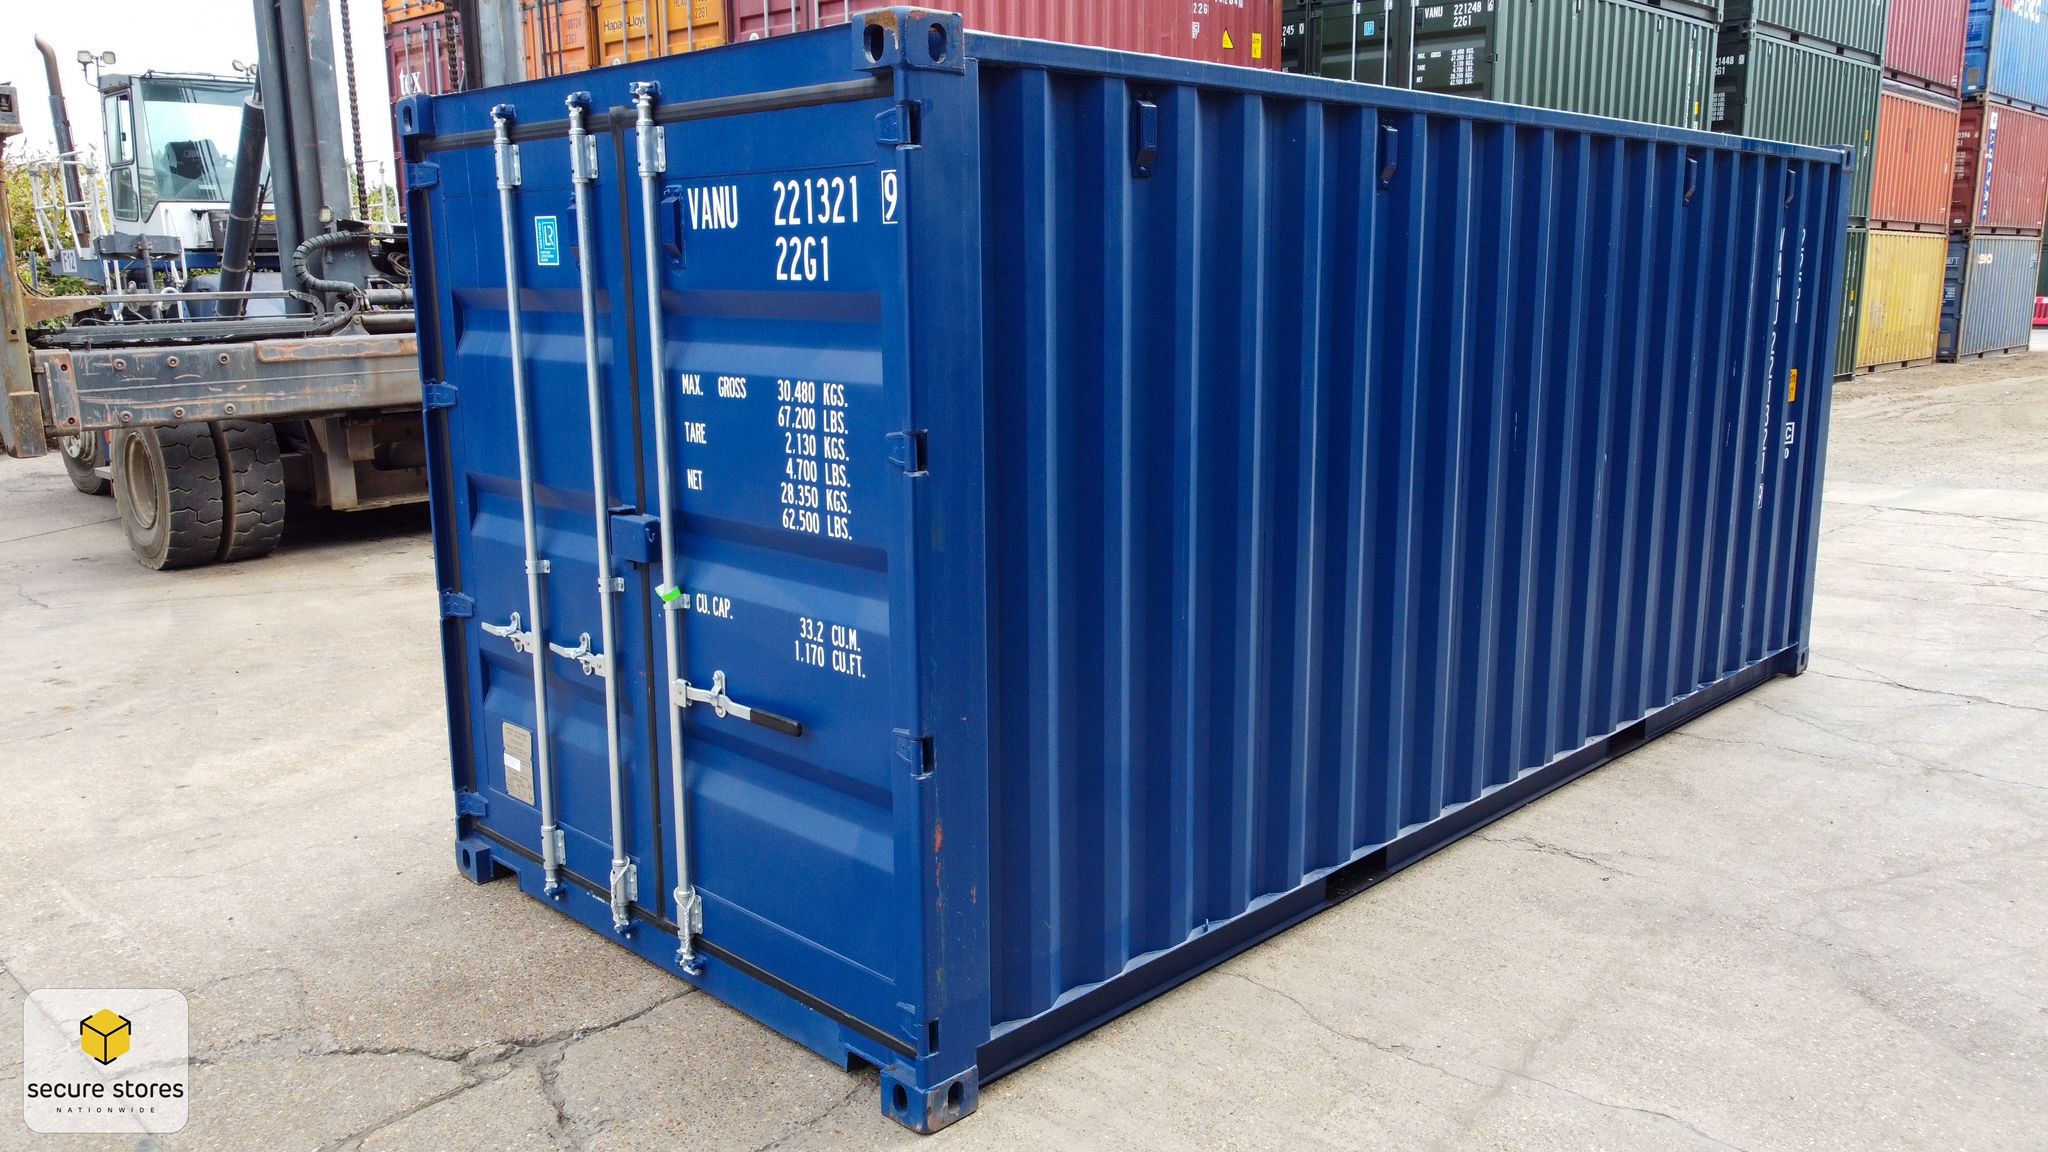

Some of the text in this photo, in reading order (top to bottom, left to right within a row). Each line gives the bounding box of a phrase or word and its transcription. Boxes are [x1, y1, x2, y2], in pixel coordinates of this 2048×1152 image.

[1425, 6, 1443, 19] VANU
[1453, 2, 1482, 15] 221248
[1453, 15, 1472, 27] 22G1
[688, 171, 899, 230] VANU 221321 9
[775, 235, 830, 282] 22G1
[682, 373, 849, 408] MAX. GROSS 30.480 KGS.
[778, 406, 849, 434] 67.200 LBS.
[684, 421, 850, 461] TARE 2.130 KGS.
[786, 457, 851, 487] 4.700 LBS.
[687, 468, 852, 514] NET 28.350 KGS.
[782, 507, 853, 540] 62.500 LBS.
[696, 593, 862, 652] CU. CAP. 33.2 CU.M.
[794, 639, 866, 678] 1.170 CU.FT.
